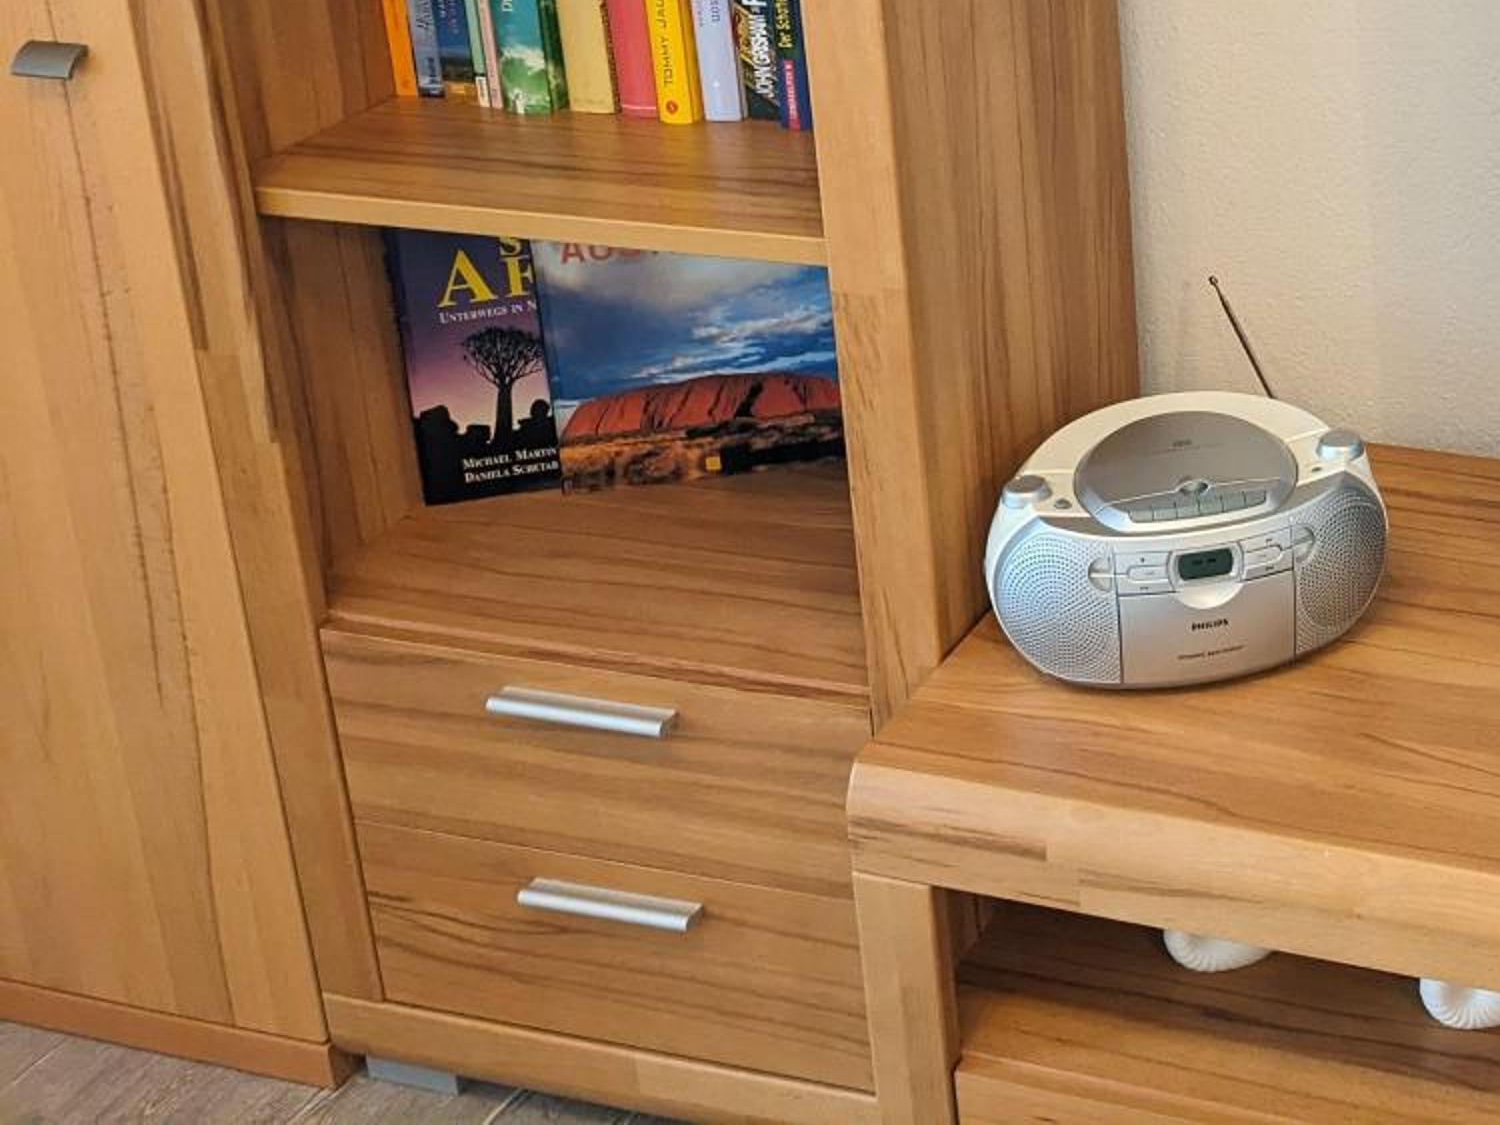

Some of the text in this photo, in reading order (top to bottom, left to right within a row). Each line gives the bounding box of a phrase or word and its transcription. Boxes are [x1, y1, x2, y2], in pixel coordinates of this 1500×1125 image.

[657, 36, 674, 89] TOMMY
[754, 64, 776, 98] JOHN
[439, 305, 507, 324] UNTERWEGS
[511, 303, 523, 315] IN
[462, 454, 512, 470] MICHAEL
[464, 468, 511, 484] DANIELA
[1191, 618, 1229, 632] PHILIPS
